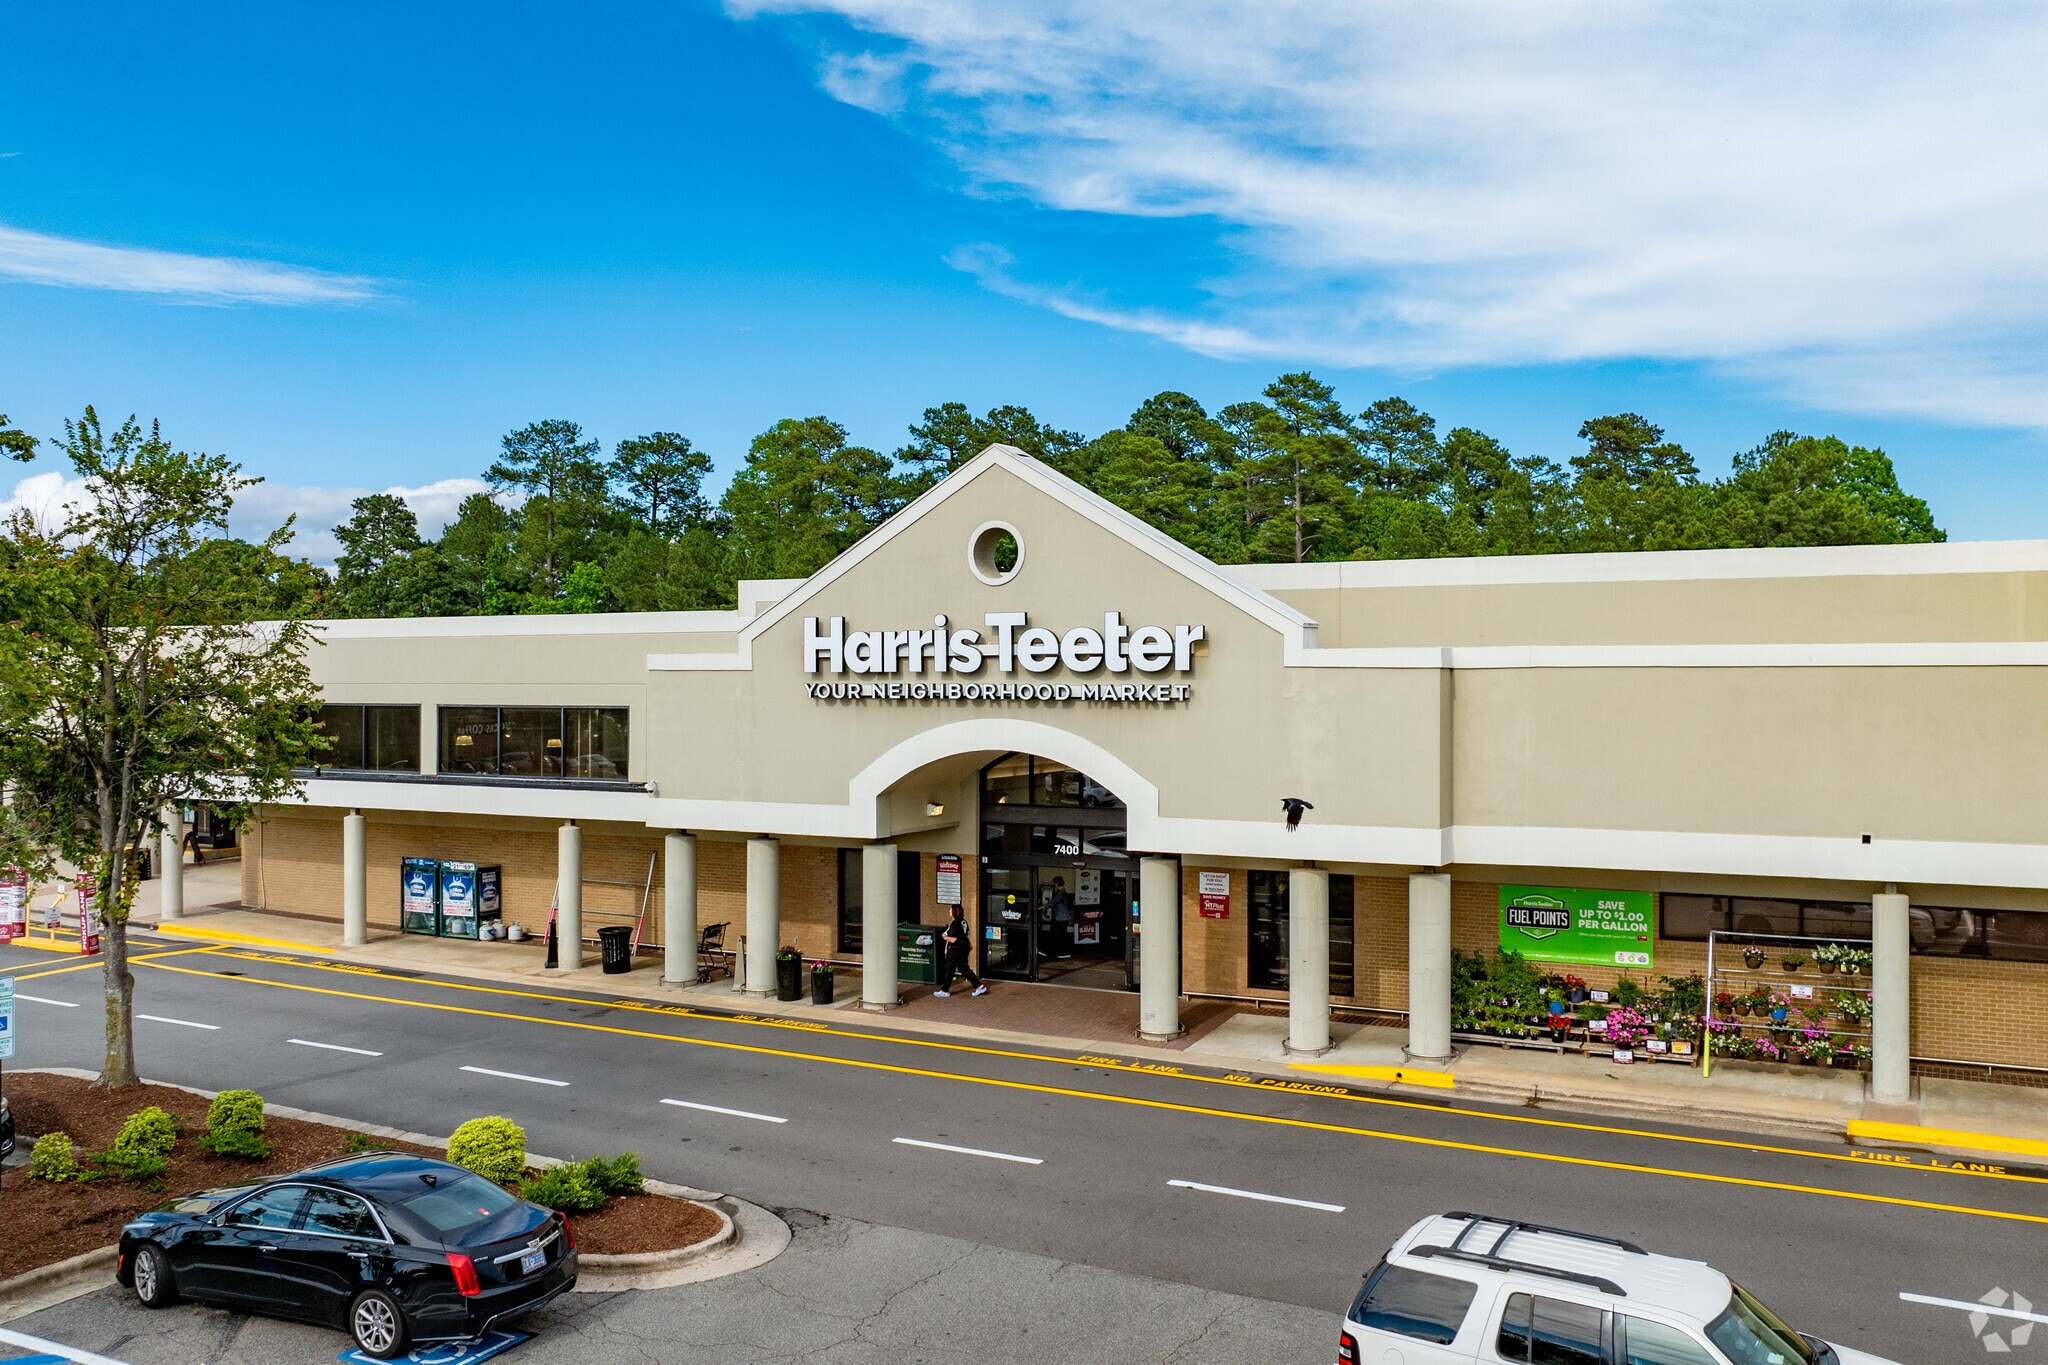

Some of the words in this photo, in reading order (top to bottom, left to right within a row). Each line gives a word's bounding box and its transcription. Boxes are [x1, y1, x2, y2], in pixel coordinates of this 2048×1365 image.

[803, 614, 982, 673] Harris
[984, 611, 1205, 672] Teeter
[804, 682, 863, 700] YOUR
[870, 682, 1072, 701] NEIGHBORHOOD
[1081, 683, 1191, 702] MARKET
[1054, 845, 1079, 855] 7400
[1597, 900, 1625, 910] SAVE
[1509, 909, 1531, 924] FUEL
[1533, 910, 1568, 926] POINTS
[1579, 909, 1595, 918] UP
[1596, 910, 1611, 919] TO
[1613, 912, 1644, 922] $1.00
[1079, 926, 1095, 934] SAVE
[1578, 919, 1599, 929] PER
[1602, 921, 1648, 932] GALLON
[613, 999, 650, 1009] FIRE
[654, 1005, 695, 1014] LANE
[760, 1016, 829, 1030] PARKING
[1077, 1055, 1122, 1066] FIRE
[1129, 1061, 1183, 1074] LANE
[1223, 1074, 1251, 1083] NO
[1260, 1078, 1349, 1095] PARKING
[1850, 1150, 1911, 1164] FIRE
[1931, 1159, 2006, 1175] LANE
